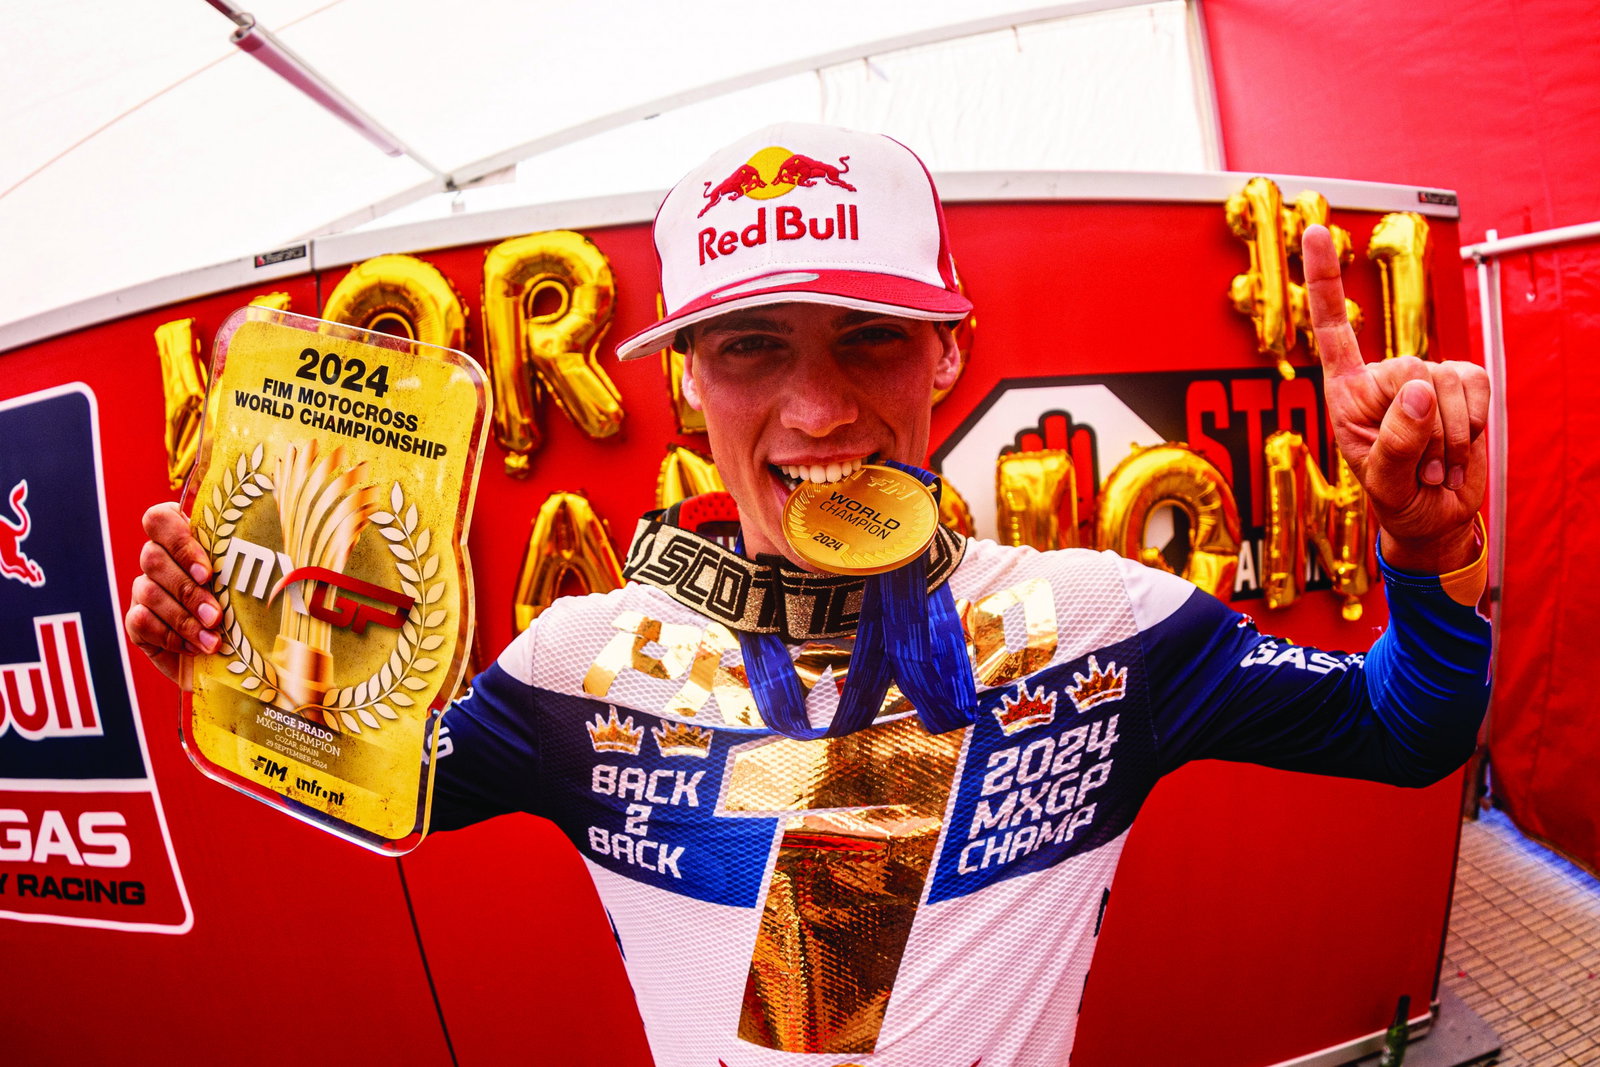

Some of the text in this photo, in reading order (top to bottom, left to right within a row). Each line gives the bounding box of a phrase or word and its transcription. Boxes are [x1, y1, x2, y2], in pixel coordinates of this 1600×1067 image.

[697, 203, 859, 267] Red Bull
[295, 347, 390, 399] 2024
[234, 389, 448, 461] WORLD CHAMPIONSHIP
[262, 377, 419, 433] FIM MOTOCROSS
[1186, 377, 1338, 528] STO
[818, 500, 892, 541] CHAMPION
[829, 491, 901, 531] WORLD
[812, 532, 844, 552] 2024
[220, 536, 416, 636] MXGP
[0, 616, 101, 737] ull
[255, 714, 341, 757] MXGP CHAMPION
[263, 706, 334, 743] JORGE PRADO
[250, 755, 289, 783] FIM
[265, 739, 328, 770] 29 SEPTEMBER 2024
[299, 744, 320, 758] SPAIN
[980, 713, 1121, 797] 2024
[591, 764, 707, 808] BACK
[967, 758, 1114, 840] MXGP
[624, 802, 653, 837] 2
[957, 801, 1098, 876] CHAMP
[587, 825, 686, 879] BACK
[16, 873, 147, 906] RACING
[714, 719, 973, 1056] 7
